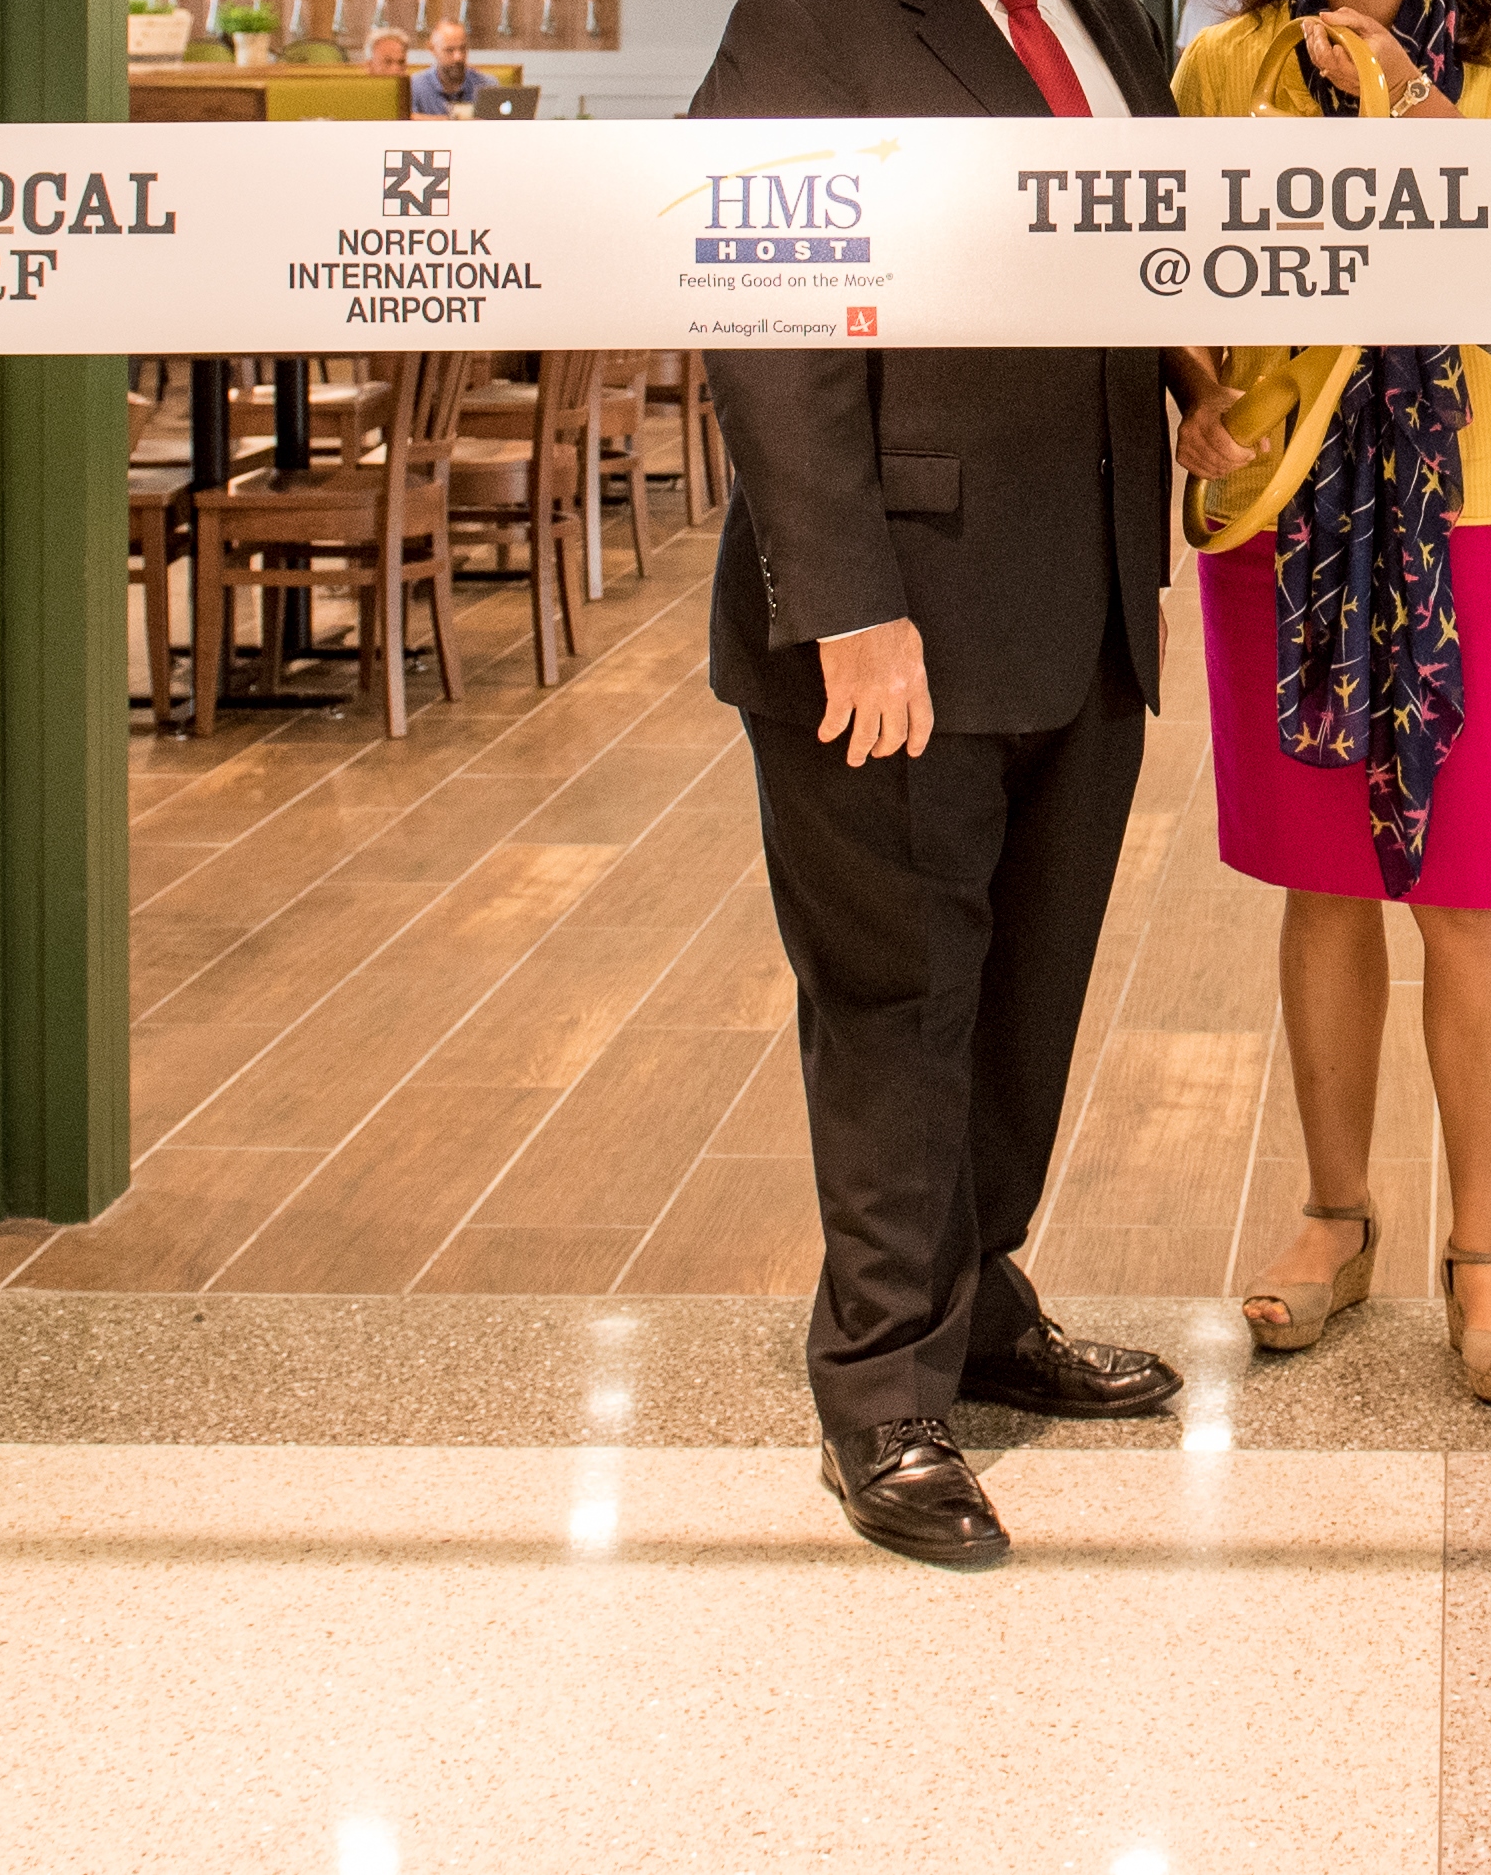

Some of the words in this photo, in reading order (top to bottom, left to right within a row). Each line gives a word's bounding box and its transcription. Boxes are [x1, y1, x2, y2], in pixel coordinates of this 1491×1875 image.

[705, 175, 861, 229] HMS
[1019, 170, 1186, 232] THE
[1222, 167, 1488, 231] LOCAL
[339, 229, 490, 255] NORFOLK
[719, 240, 847, 260] HOST
[290, 263, 541, 289] INTERNATIONAL
[678, 274, 735, 290] Feeling
[741, 274, 781, 287] Good
[788, 277, 806, 287] on
[813, 274, 838, 287] the
[347, 297, 486, 323] AIRPORT
[689, 321, 707, 332] An
[712, 320, 768, 337] Autogrill
[773, 320, 836, 336] Company
